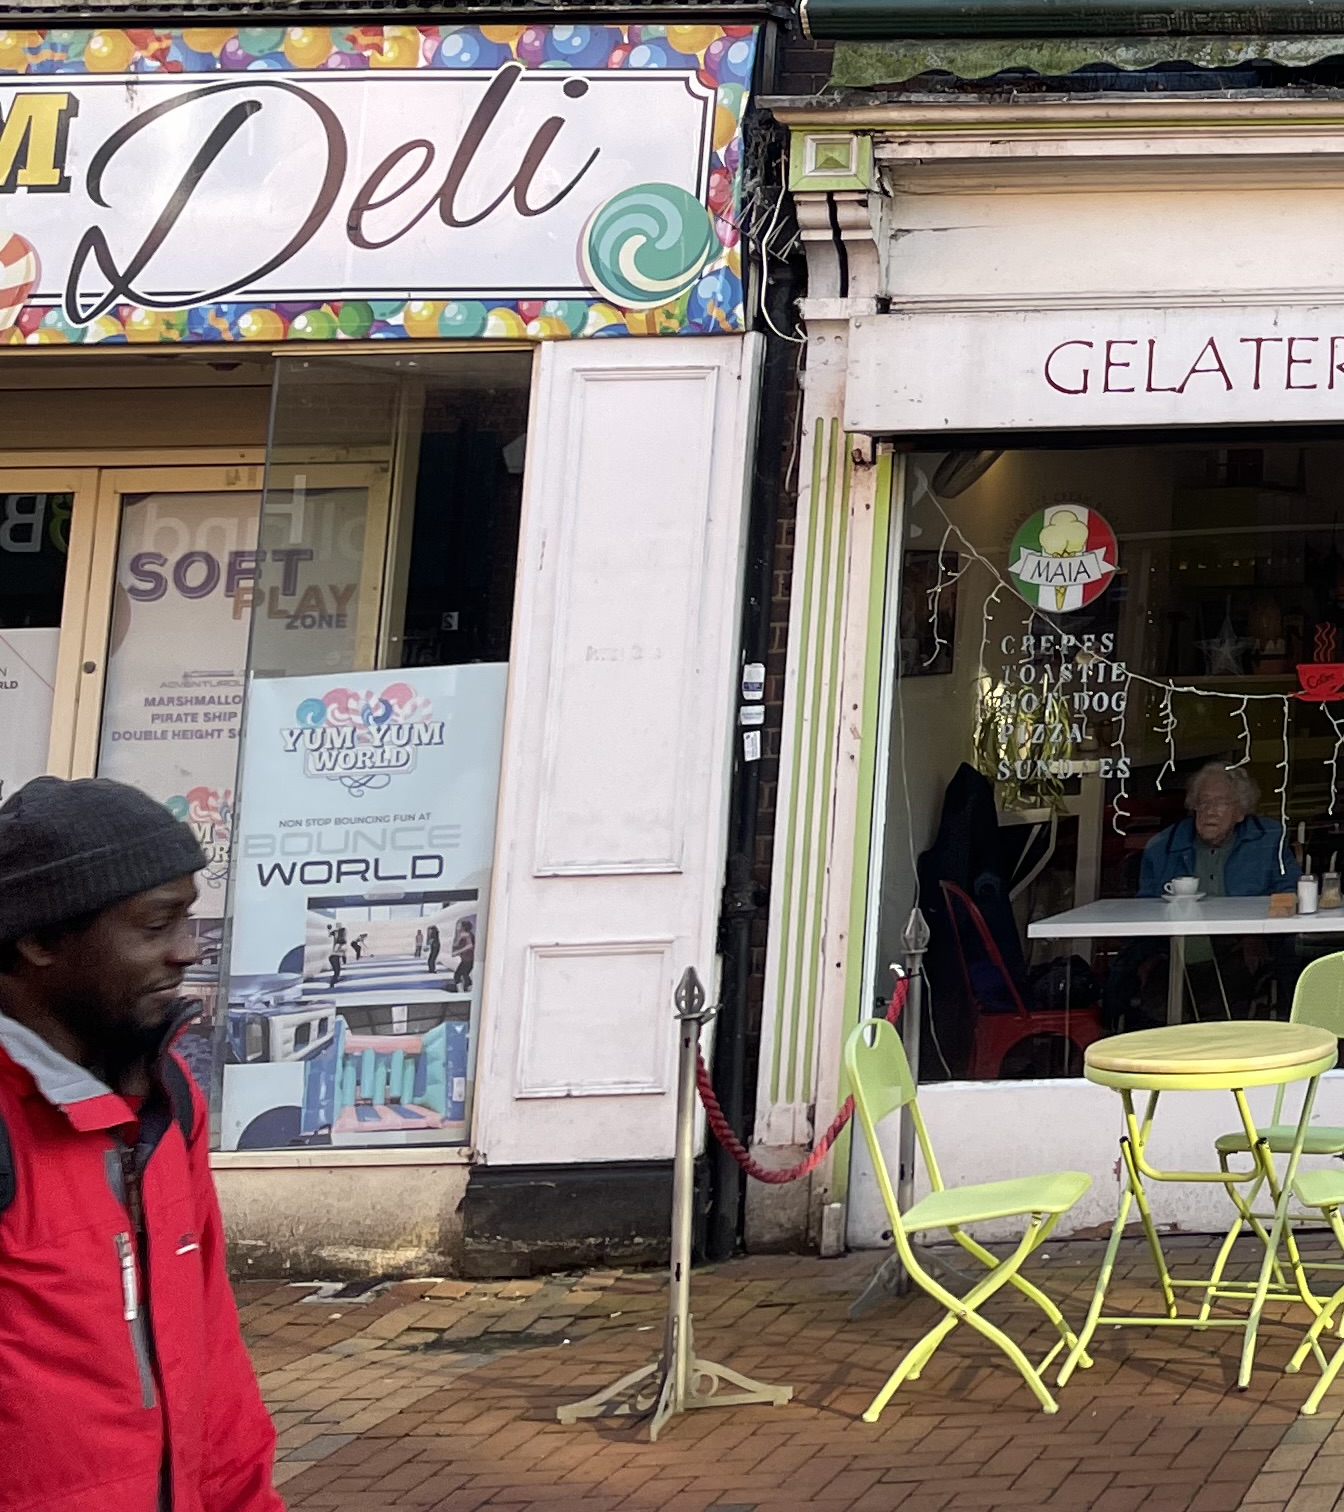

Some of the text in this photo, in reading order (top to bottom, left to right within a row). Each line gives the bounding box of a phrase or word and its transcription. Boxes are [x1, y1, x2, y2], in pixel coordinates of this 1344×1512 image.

[65, 63, 600, 323] Deli
[127, 549, 313, 602] SOFT
[1030, 560, 1091, 583] MAIA
[232, 583, 357, 620] PLAY
[285, 613, 347, 630] ZONE
[1001, 633, 1114, 655] CREPES
[1073, 691, 1127, 712] DOG
[151, 712, 238, 724] PIRATE SHIP
[112, 730, 168, 741] DOUBLE
[172, 728, 224, 740] HEIGHT
[280, 721, 445, 752] YUM YUM
[999, 723, 1083, 744] PIZZA
[308, 746, 410, 772] WORLD
[279, 812, 432, 828] NON STOP BOUNCING FUN AT
[243, 824, 462, 858] BOUNCE
[257, 854, 444, 887] WORLD
